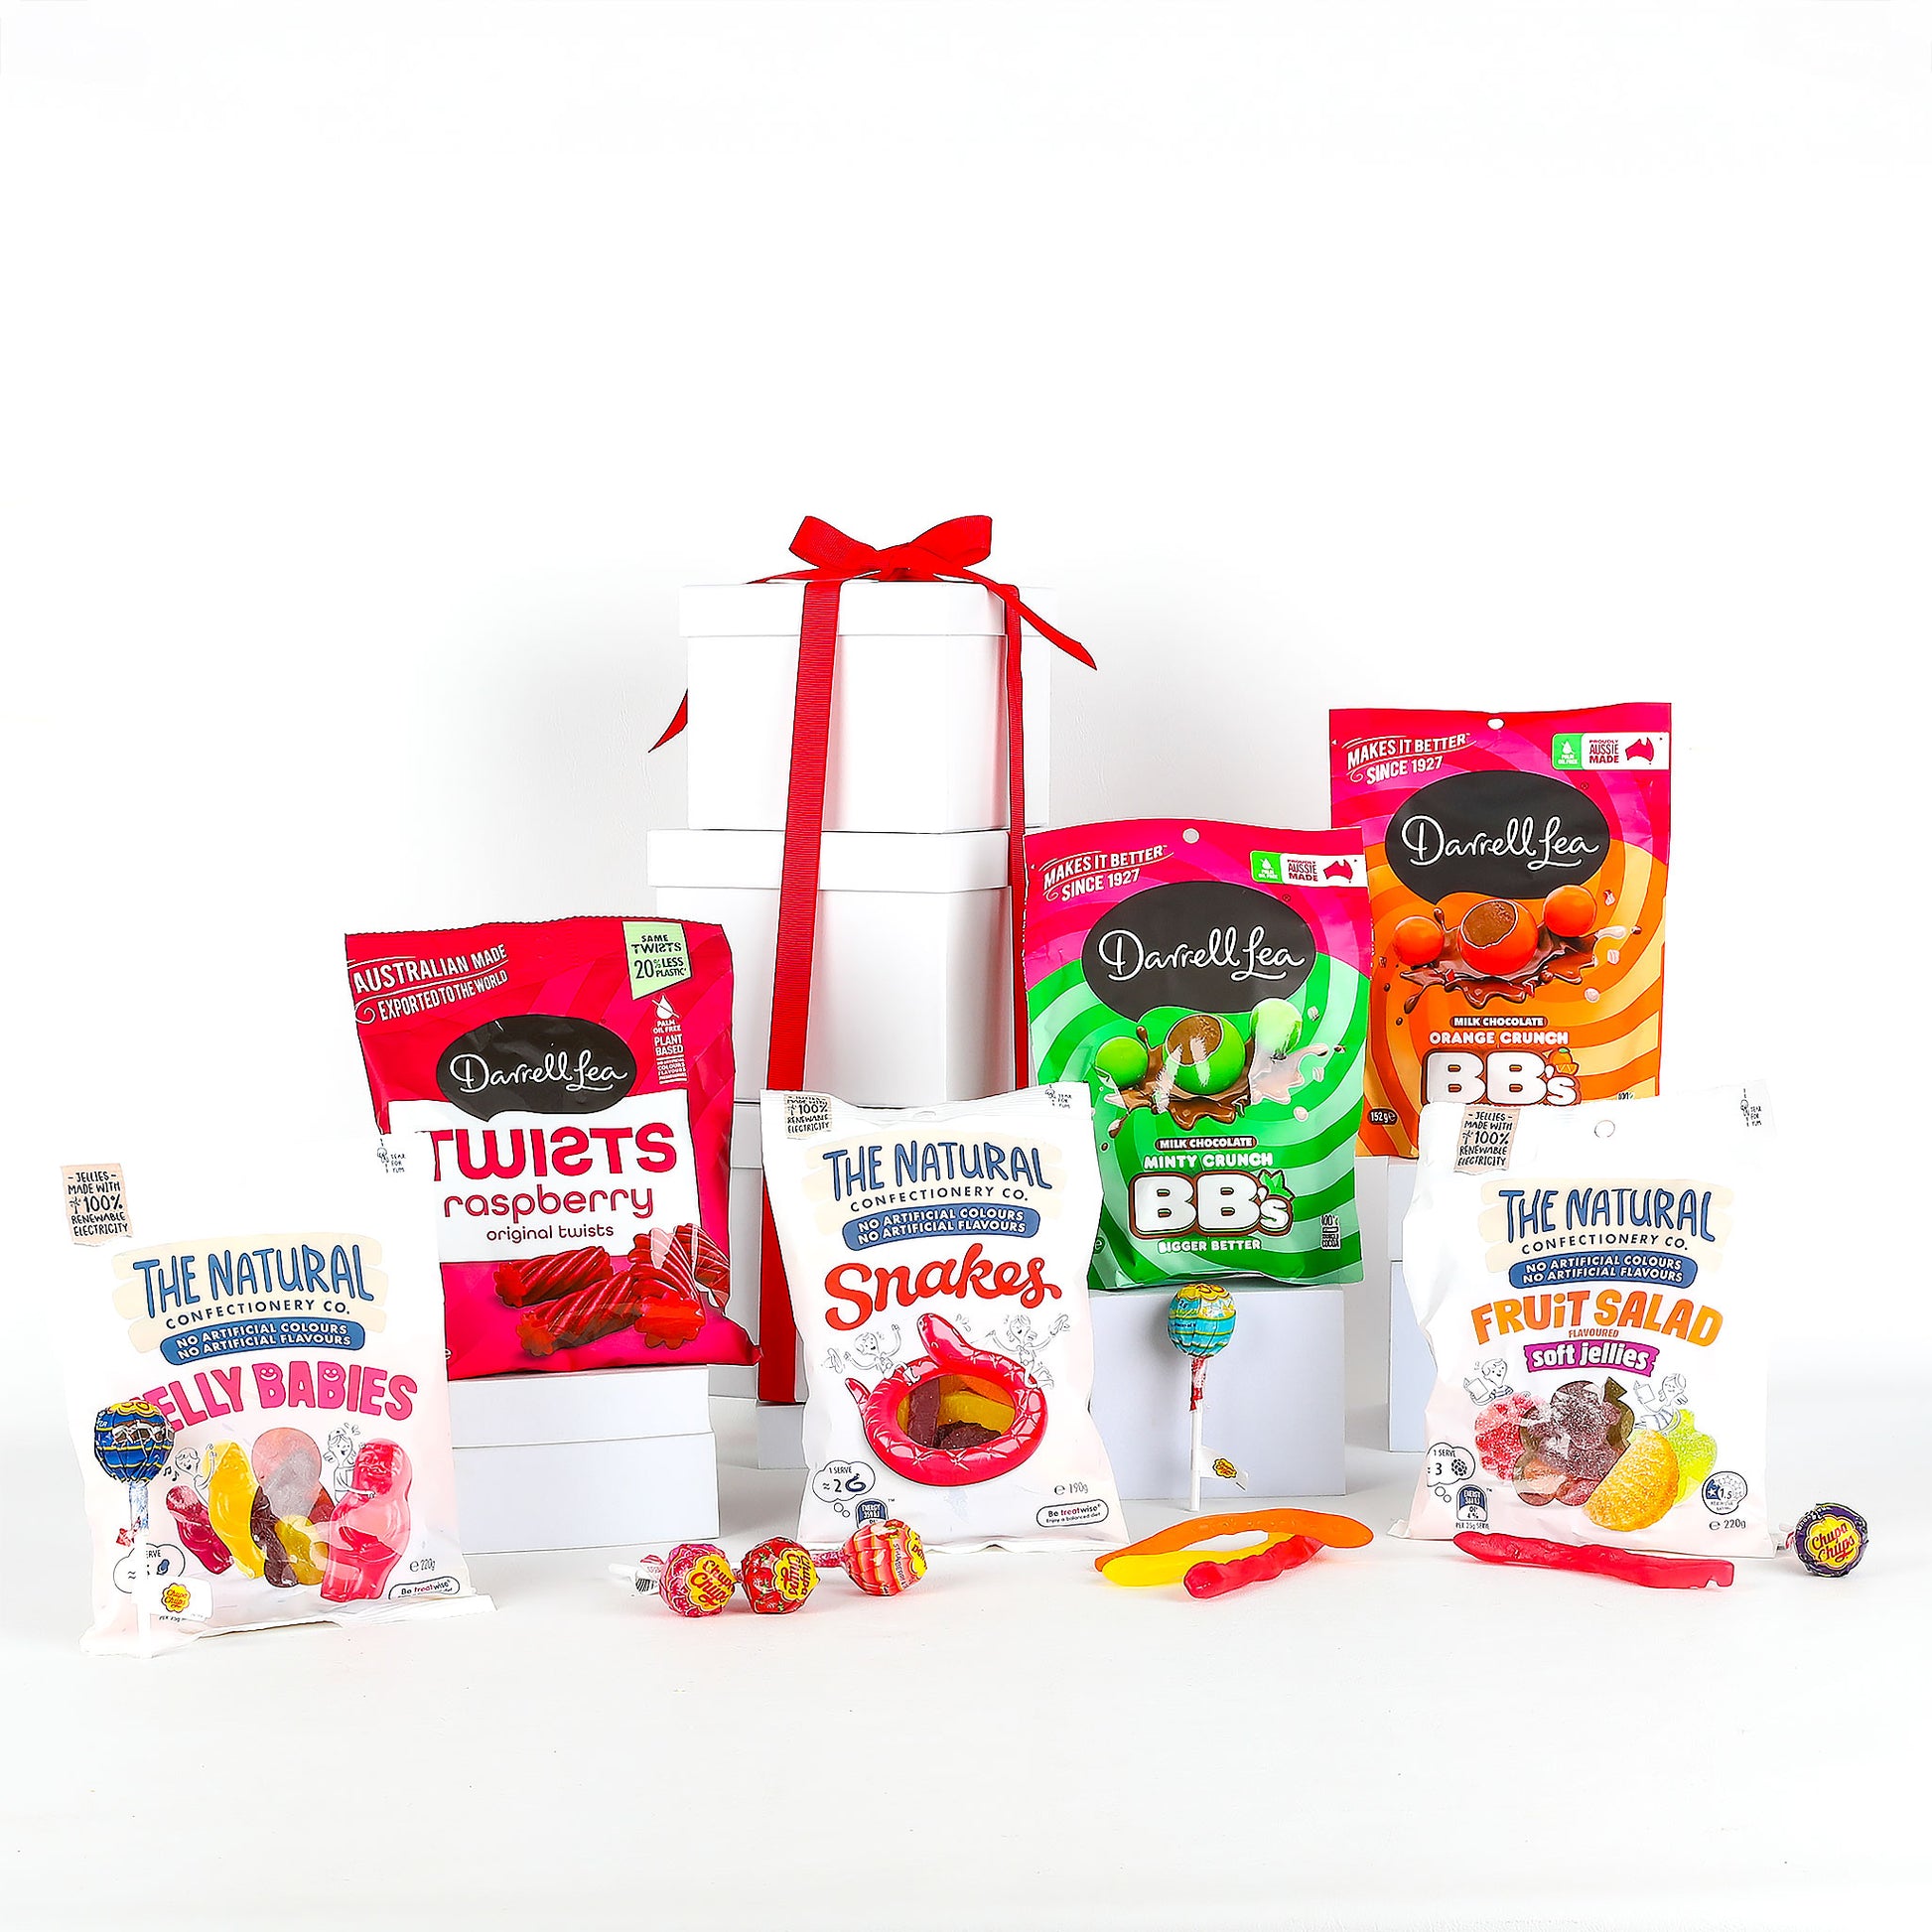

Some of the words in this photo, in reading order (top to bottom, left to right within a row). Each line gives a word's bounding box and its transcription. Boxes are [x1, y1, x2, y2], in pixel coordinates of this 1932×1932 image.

[1347, 740, 1396, 770] MAKES
[1399, 739, 1412, 755] IT
[1589, 744, 1618, 755] AUSSIE
[1366, 759, 1408, 785] SINCE
[1412, 756, 1443, 772] 1927
[1401, 815, 1536, 866] Darrell
[1528, 816, 1599, 871] Lea
[1043, 856, 1092, 890] MAKES
[1095, 854, 1107, 869] IT
[1288, 864, 1316, 874] AUSSIE
[1289, 873, 1318, 882] MADE
[1061, 875, 1104, 901] SINCE
[1107, 868, 1140, 888] 1927
[631, 942, 682, 954] TWISTS
[1097, 926, 1240, 981] Darrell
[1231, 925, 1305, 981] Lea
[353, 955, 470, 994] AUSTRALIAN
[471, 944, 506, 970] MADE
[634, 958, 661, 979] 20%
[661, 957, 684, 967] LESS
[377, 987, 442, 1021] EXPORTED
[442, 987, 456, 1005] TO
[454, 981, 476, 1001] THE
[474, 969, 508, 993] WORLD
[1453, 1018, 1481, 1027] MILK
[1482, 1017, 1544, 1027] CHOCOLATE
[654, 1034, 682, 1046] PLANT
[1430, 1032, 1494, 1044] ORANGE
[1500, 1032, 1569, 1044] CRUNCH
[655, 1044, 683, 1056] BASED
[449, 1050, 572, 1093] Darrell
[566, 1049, 627, 1092] Lea
[1425, 1049, 1581, 1106] BB's
[799, 1102, 828, 1114] 100%
[1475, 1112, 1505, 1121] JELLIES
[787, 1122, 829, 1133] ELECTRICITY
[1464, 1121, 1487, 1130] MADE
[1490, 1122, 1513, 1131] WITH
[1160, 1139, 1187, 1150] MILK
[1188, 1137, 1253, 1149] CHOCOLATE
[1475, 1131, 1510, 1145] 100%
[430, 1123, 677, 1181] TWISTS
[1457, 1156, 1506, 1166] ELECTRICITY
[1459, 1145, 1507, 1156] RENEWABLE
[823, 1146, 885, 1201] THE
[895, 1141, 1052, 1189] NATURAL
[1144, 1155, 1197, 1170] MINTY
[1202, 1153, 1273, 1167] CRUNCH
[68, 1183, 93, 1194] MADE
[95, 1181, 120, 1192] WITH
[75, 1172, 109, 1182] JELLIES
[83, 1193, 123, 1212] 100%
[444, 1184, 653, 1224] raspberry
[851, 1186, 994, 1212] CONFECTIONERY
[1002, 1187, 1029, 1201] CO.
[1131, 1172, 1293, 1237] BB's
[71, 1212, 126, 1224] RENEWABLE
[858, 1220, 880, 1232] NO
[884, 1209, 956, 1227] ARTIFICIAL
[959, 1207, 1024, 1221] COLOURS
[1499, 1188, 1558, 1243] THE
[1566, 1188, 1716, 1242] NATURAL
[73, 1223, 128, 1236] ELECTRICITY
[486, 1224, 552, 1243] original
[559, 1223, 614, 1239] twists
[858, 1232, 880, 1245] NO
[883, 1221, 954, 1239] ARTIFICIAL
[958, 1220, 1026, 1233] FLAVOURS
[1158, 1240, 1206, 1253] BIGGER
[1211, 1240, 1262, 1251] BETTER
[1522, 1234, 1659, 1255] CONFECTIONERY
[1665, 1236, 1688, 1251] CO.
[1526, 1262, 1546, 1273] NO
[1551, 1256, 1620, 1270] ARTIFICIAL
[1624, 1256, 1682, 1271] COLOURS
[133, 1255, 200, 1318] THE
[208, 1245, 374, 1302] NATURAL
[1523, 1273, 1545, 1284] NO
[1546, 1267, 1615, 1281] ARTIFICIAL
[1619, 1267, 1683, 1282] FLAVOURS
[824, 1243, 1062, 1331] Snakes
[166, 1300, 315, 1329] CONFECTIONERY
[324, 1301, 349, 1314] CO.
[1594, 1289, 1723, 1346] SALAD
[176, 1335, 199, 1348] NO
[203, 1323, 276, 1342] ARTIFICIAL
[280, 1322, 347, 1334] COLOURS
[1569, 1328, 1619, 1338] FLAVOURED
[178, 1347, 200, 1360] NO
[203, 1335, 276, 1354] ARTIFICIAL
[280, 1333, 350, 1346] FLAVOURS
[1533, 1343, 1577, 1368] soft
[1580, 1341, 1649, 1372] jellies
[133, 1366, 244, 1432] ELLY
[252, 1361, 418, 1421] BABIES
[1436, 1462, 1443, 1475] 3
[1720, 1487, 1732, 1499] 1.5
[1724, 1518, 1746, 1529] 220g
[1812, 1523, 1848, 1550] Chupa
[1819, 1535, 1855, 1562] Chups
[782, 1554, 801, 1595] Chups
[799, 1555, 811, 1595] Chupa
